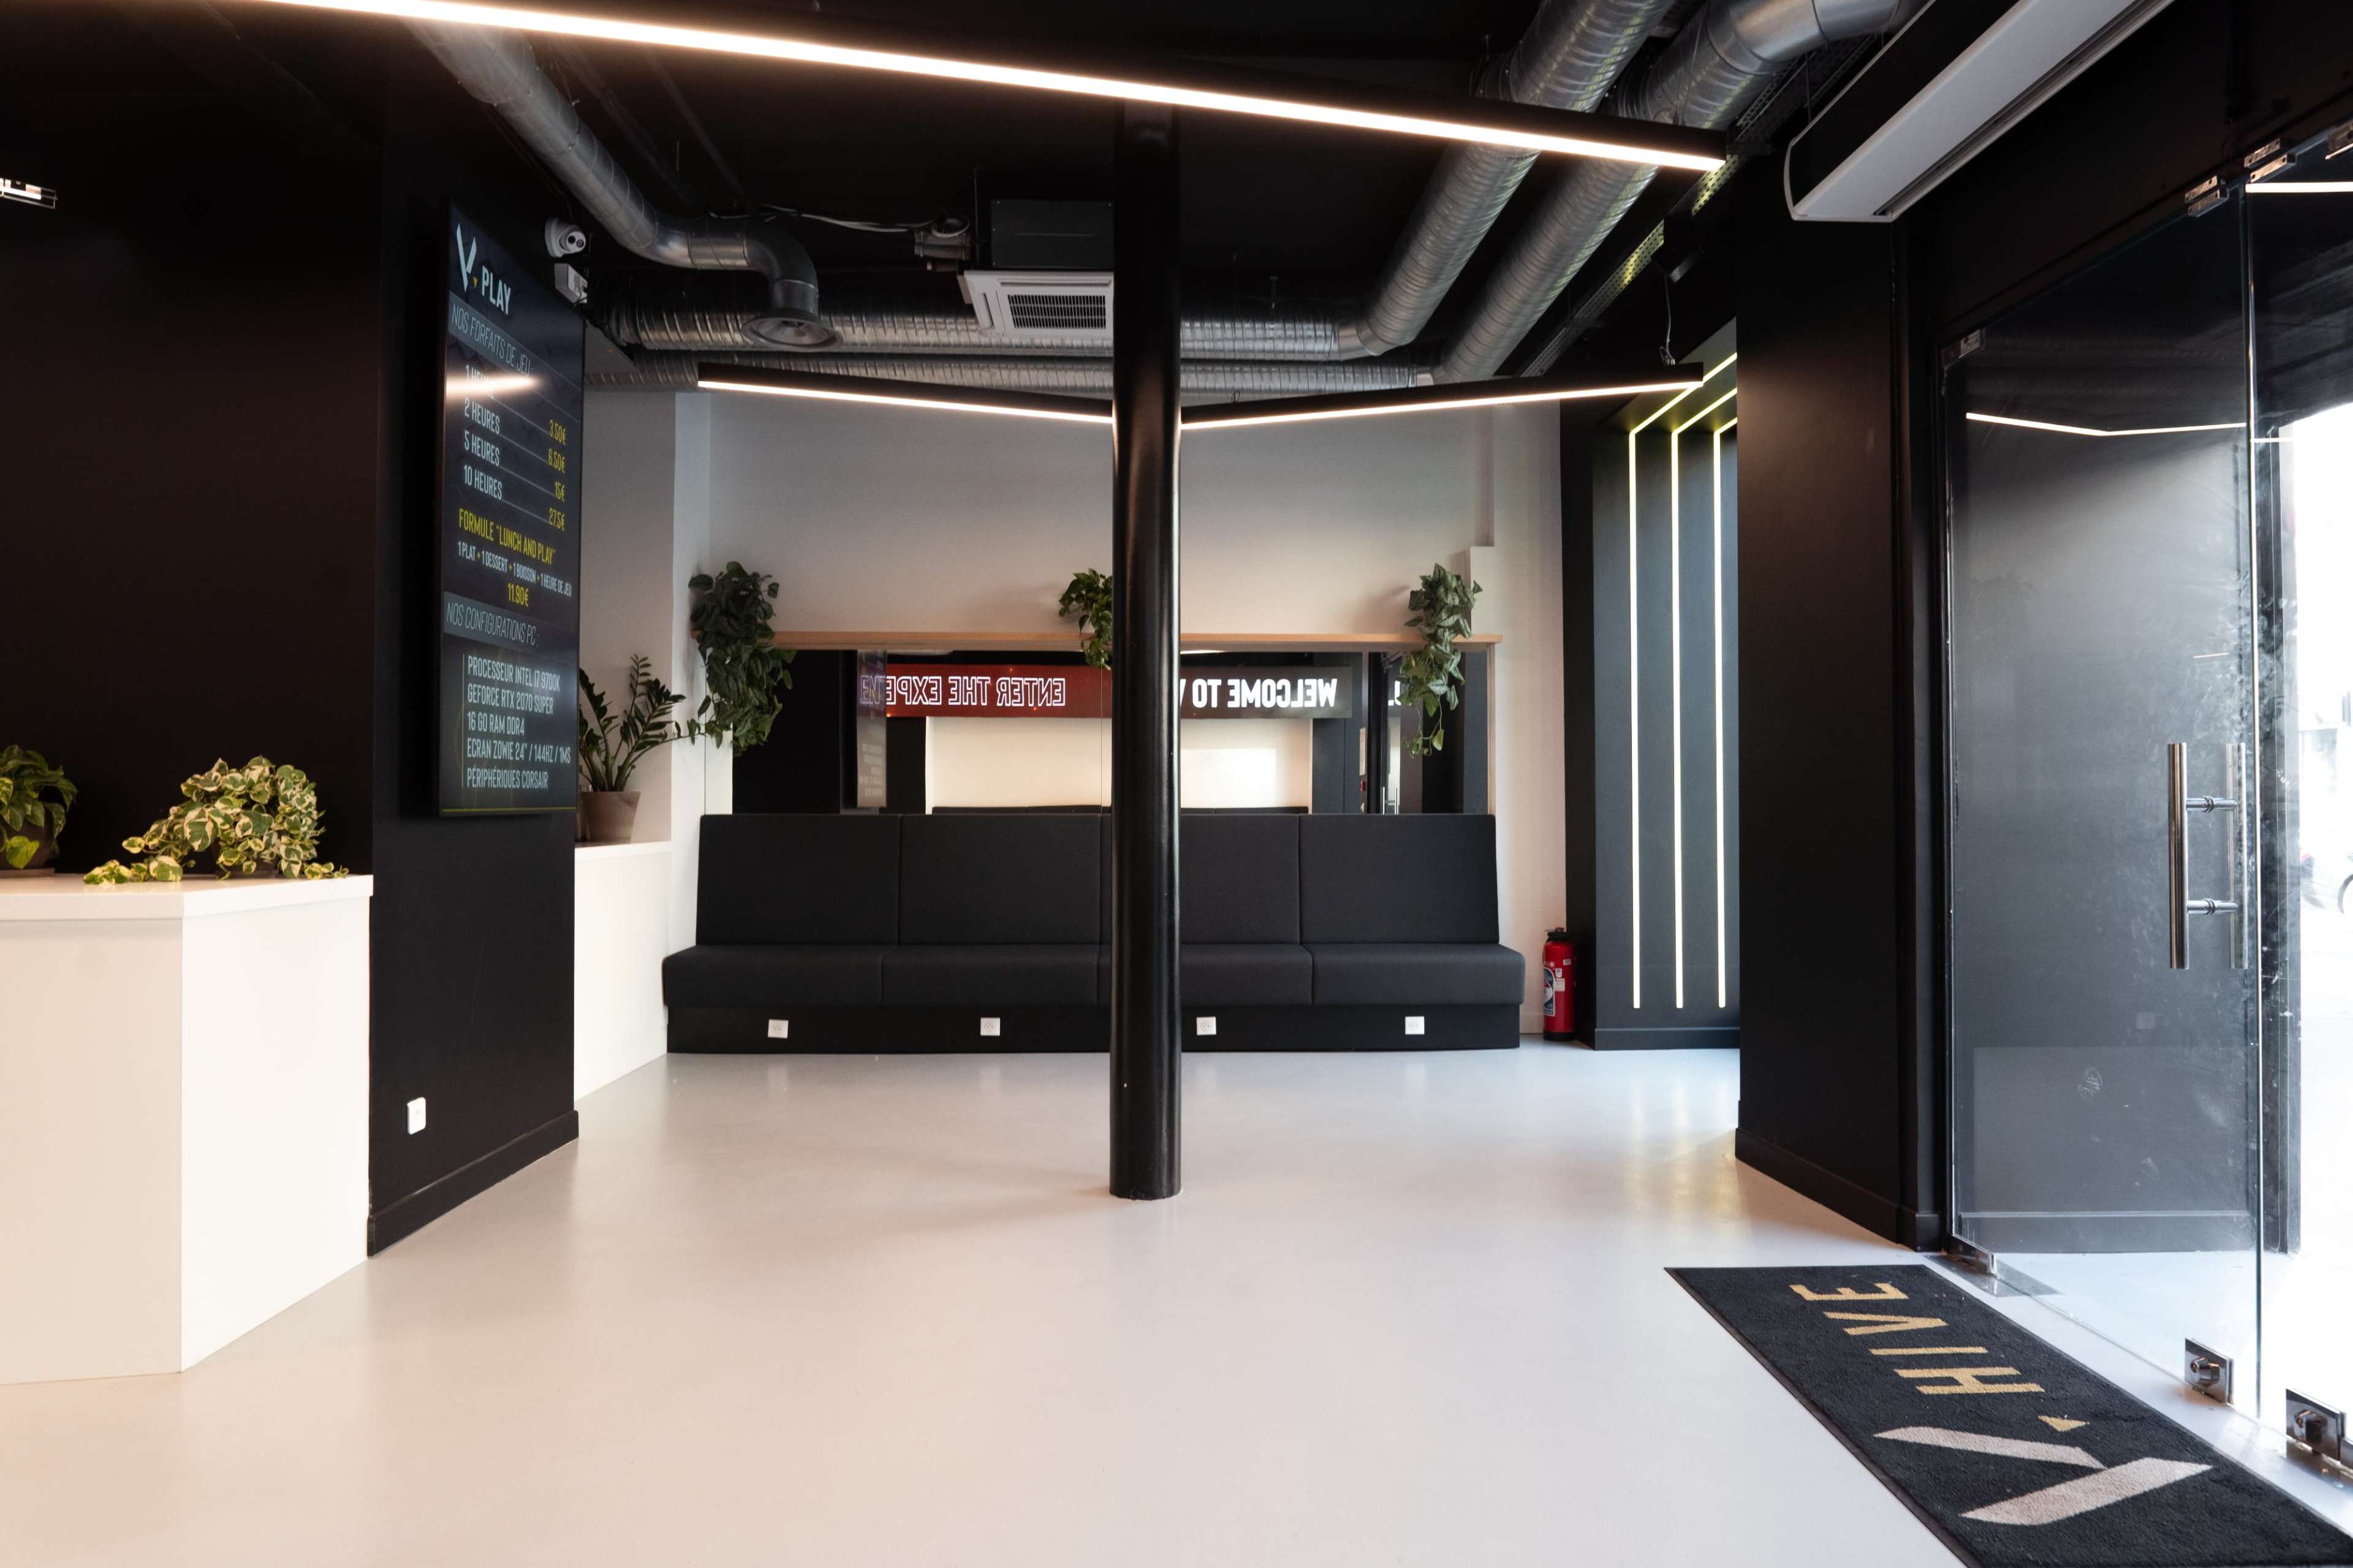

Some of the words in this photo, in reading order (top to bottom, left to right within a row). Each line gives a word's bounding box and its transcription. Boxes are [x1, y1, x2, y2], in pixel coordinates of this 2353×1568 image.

[482, 265, 511, 316] PLAY
[452, 304, 469, 333] NOS
[470, 317, 506, 359] FORFAITS
[506, 343, 516, 367] DE
[517, 353, 531, 377] JEU
[464, 397, 470, 418] 2
[471, 401, 500, 436] HEURES
[548, 448, 565, 474] 6.50€
[549, 419, 566, 445] 3.50€
[464, 430, 469, 451] 5
[471, 433, 499, 467] HEURES
[555, 480, 564, 502] 15€
[463, 464, 472, 487] 10
[474, 469, 502, 501] HEURES
[548, 507, 565, 531] 27.5€
[459, 508, 494, 541] FORMULE
[523, 537, 536, 558] AND
[508, 582, 529, 607] 11.90€
[558, 579, 563, 593] DE
[563, 581, 572, 597] JEU
[446, 602, 464, 627] NOS
[465, 606, 525, 643] CONFIGURATIONS
[468, 655, 513, 683] PROCESSEUR
[515, 666, 532, 686] INTEL
[541, 672, 561, 692] 9700K
[468, 683, 499, 706] GEFORCE
[501, 688, 515, 710] RTX
[517, 692, 532, 712] 2070
[534, 694, 553, 715] SUPER
[467, 711, 476, 731] 16
[477, 712, 488, 732] GO
[490, 714, 505, 734] RAM
[507, 716, 525, 736] DDR4
[467, 738, 491, 759] ECRAN
[493, 740, 513, 760] ZOWIE
[534, 744, 553, 763] 144HZ
[559, 746, 570, 764] 1MS
[467, 765, 520, 789] PÉRIPHÉRIQUES
[522, 770, 548, 789] CORSAIR
[1789, 1281, 2045, 1395] HIVE
